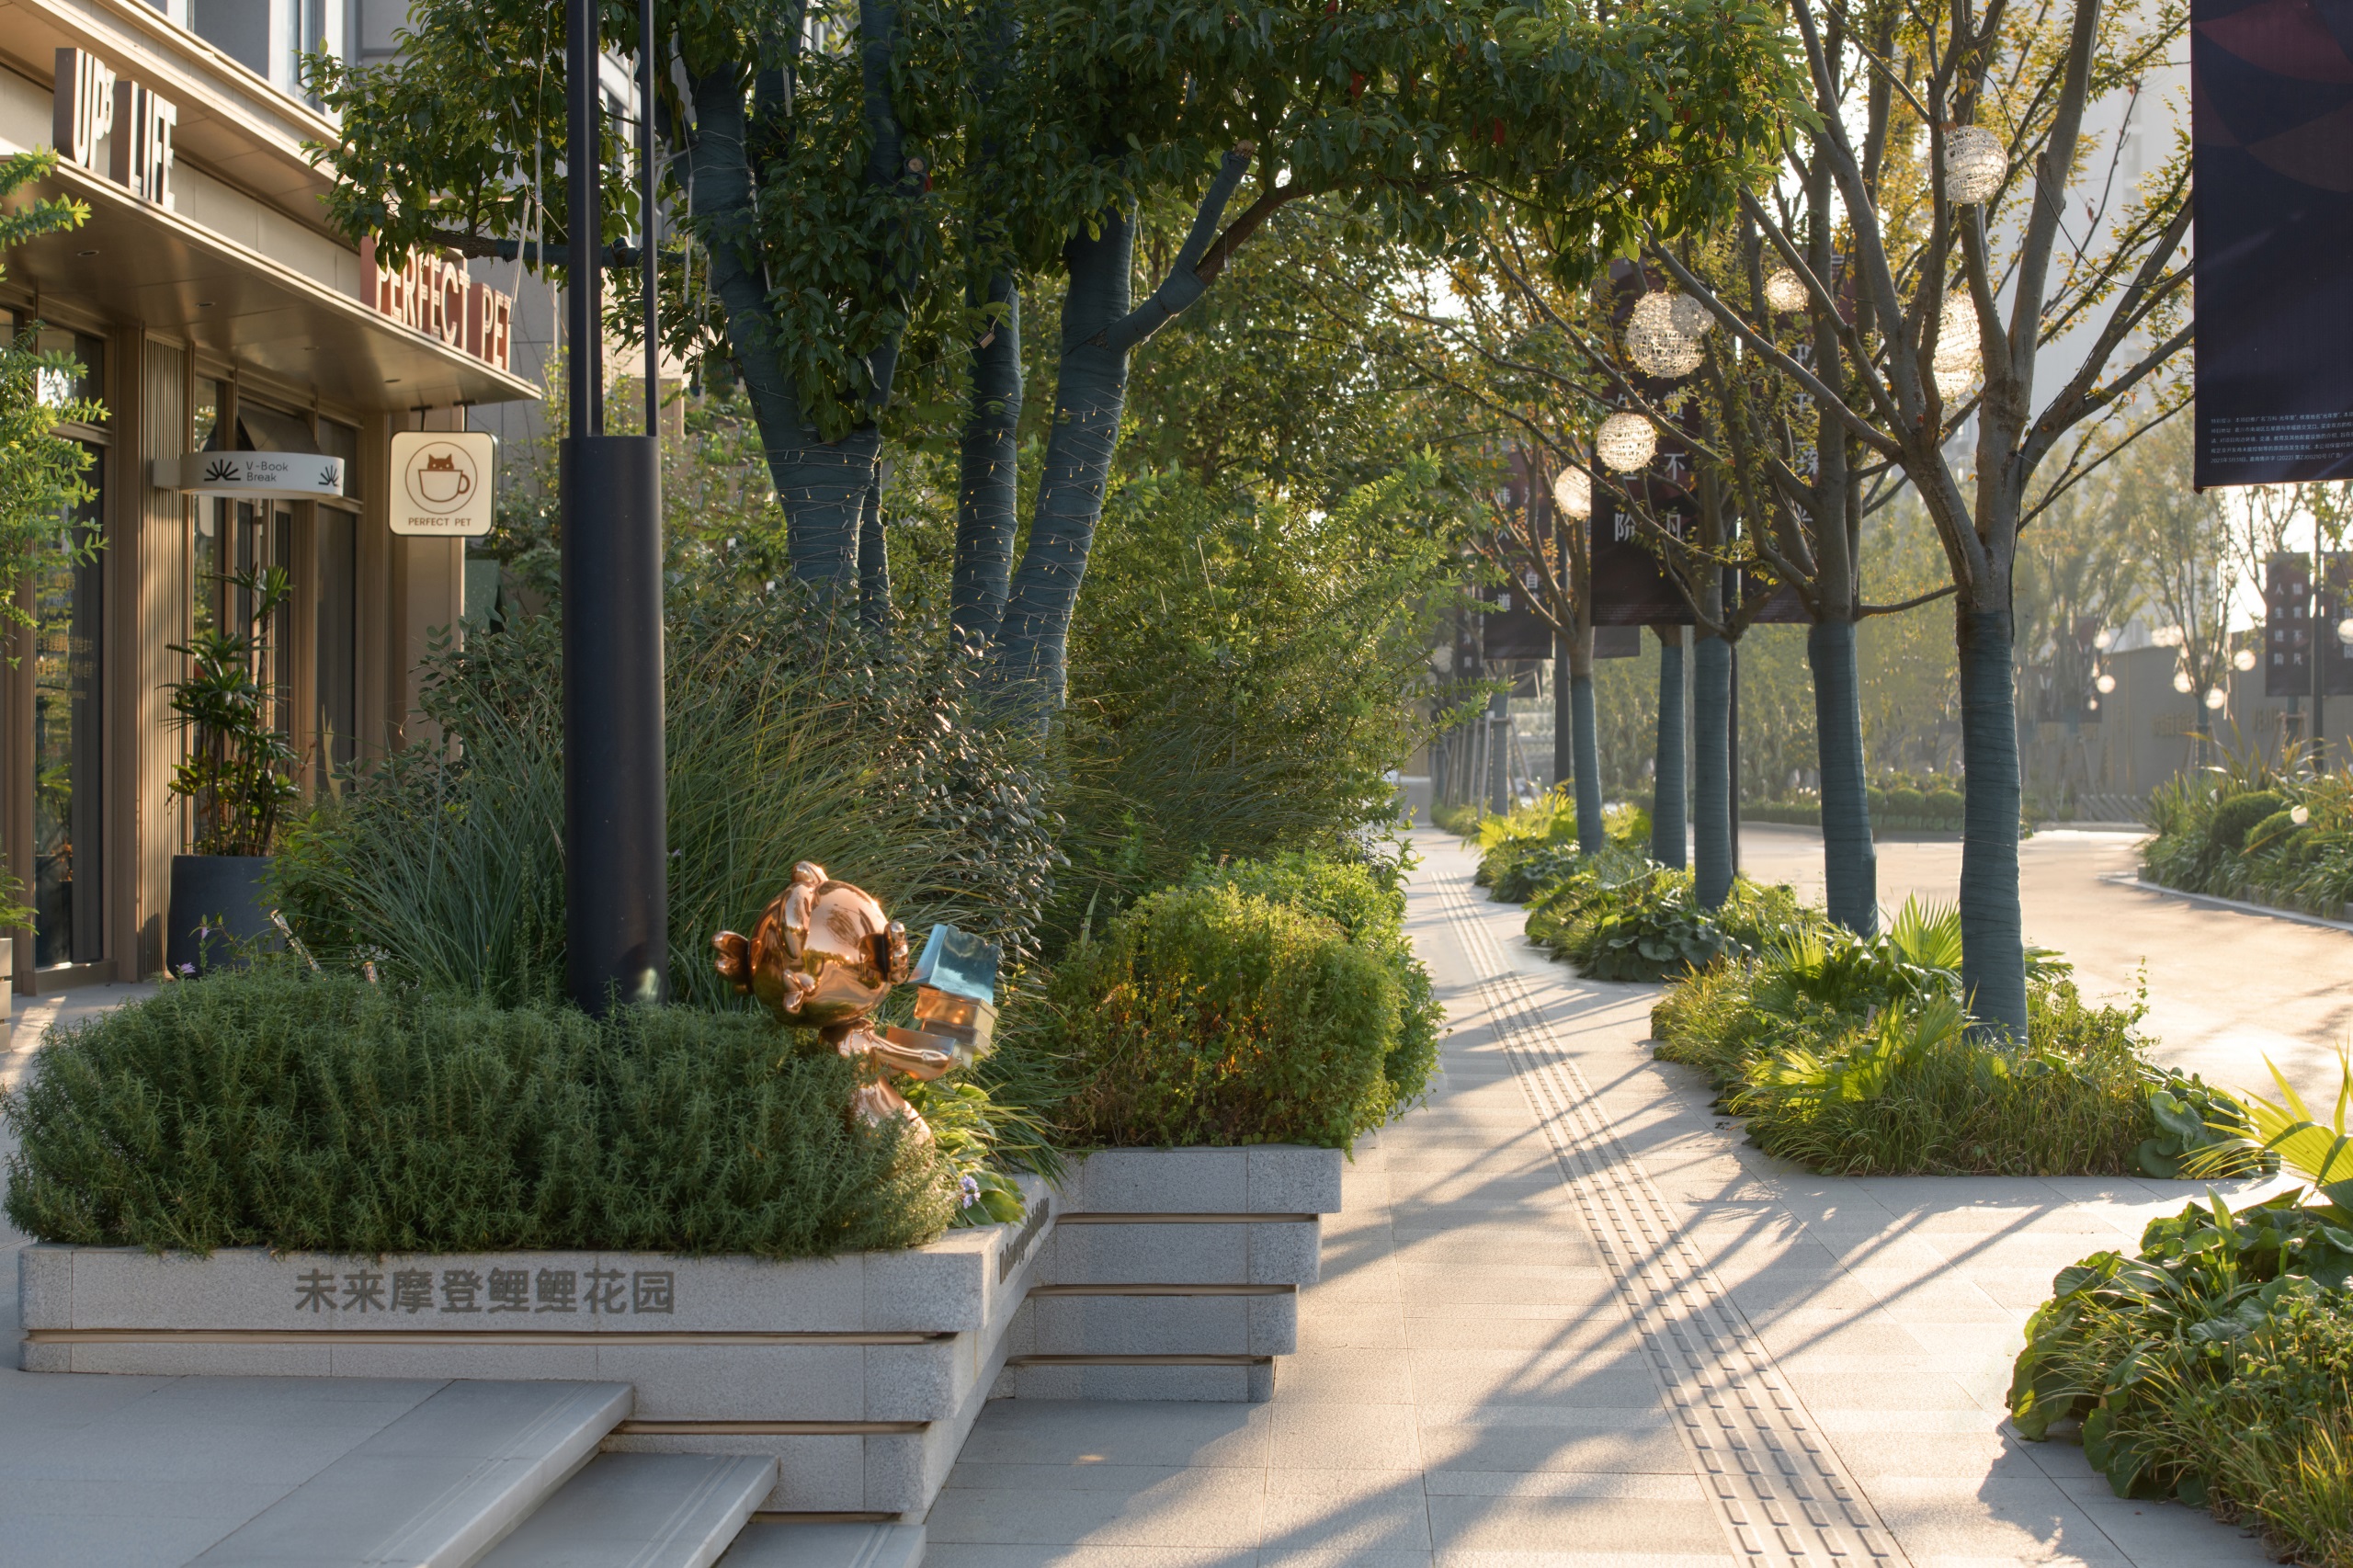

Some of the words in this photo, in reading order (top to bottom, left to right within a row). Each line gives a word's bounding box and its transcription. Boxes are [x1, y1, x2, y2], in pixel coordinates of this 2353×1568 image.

[129, 80, 176, 212] LIFE
[376, 229, 471, 353] PERFECT
[481, 282, 514, 373] PET
[246, 472, 277, 482] Break
[1664, 391, 1686, 541] 赏不凡
[408, 517, 449, 526] PERFECT
[455, 518, 472, 527] PET
[294, 1267, 675, 1314] 未来摩登鲤鲤花园
